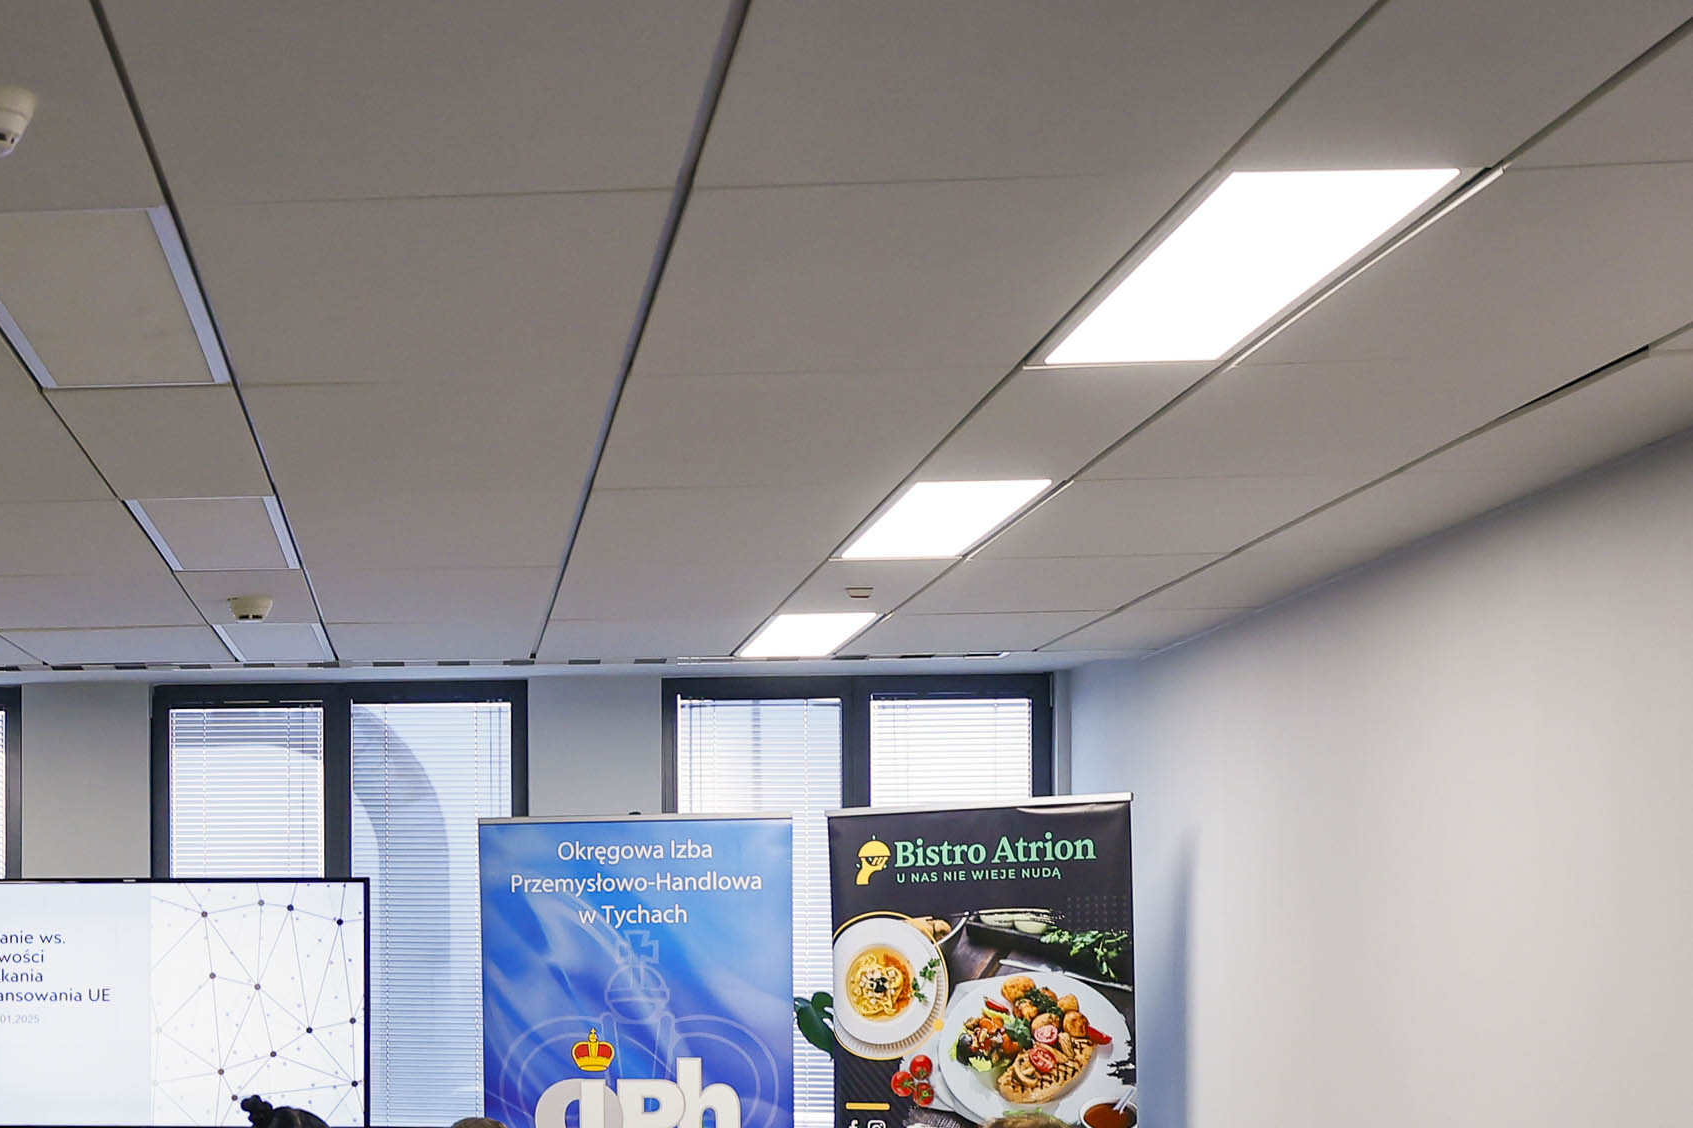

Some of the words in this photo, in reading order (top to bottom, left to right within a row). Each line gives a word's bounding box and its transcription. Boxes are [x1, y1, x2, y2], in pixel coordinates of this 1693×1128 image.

[558, 842, 664, 864] Okręgowa
[670, 840, 713, 860] Izba
[893, 838, 986, 869] Bistro
[991, 832, 1097, 864] Atrion
[510, 873, 762, 898] Przemysłowo-Handlowa
[896, 874, 906, 884] U
[910, 872, 938, 883] NAS
[943, 870, 966, 881] NIE
[971, 868, 1017, 880] WIEJE
[1021, 867, 1062, 880] NUDĄ
[578, 909, 597, 923] w
[601, 905, 688, 930] Tychach
[39, 933, 66, 944] ws.
[88, 988, 111, 1002] UE
